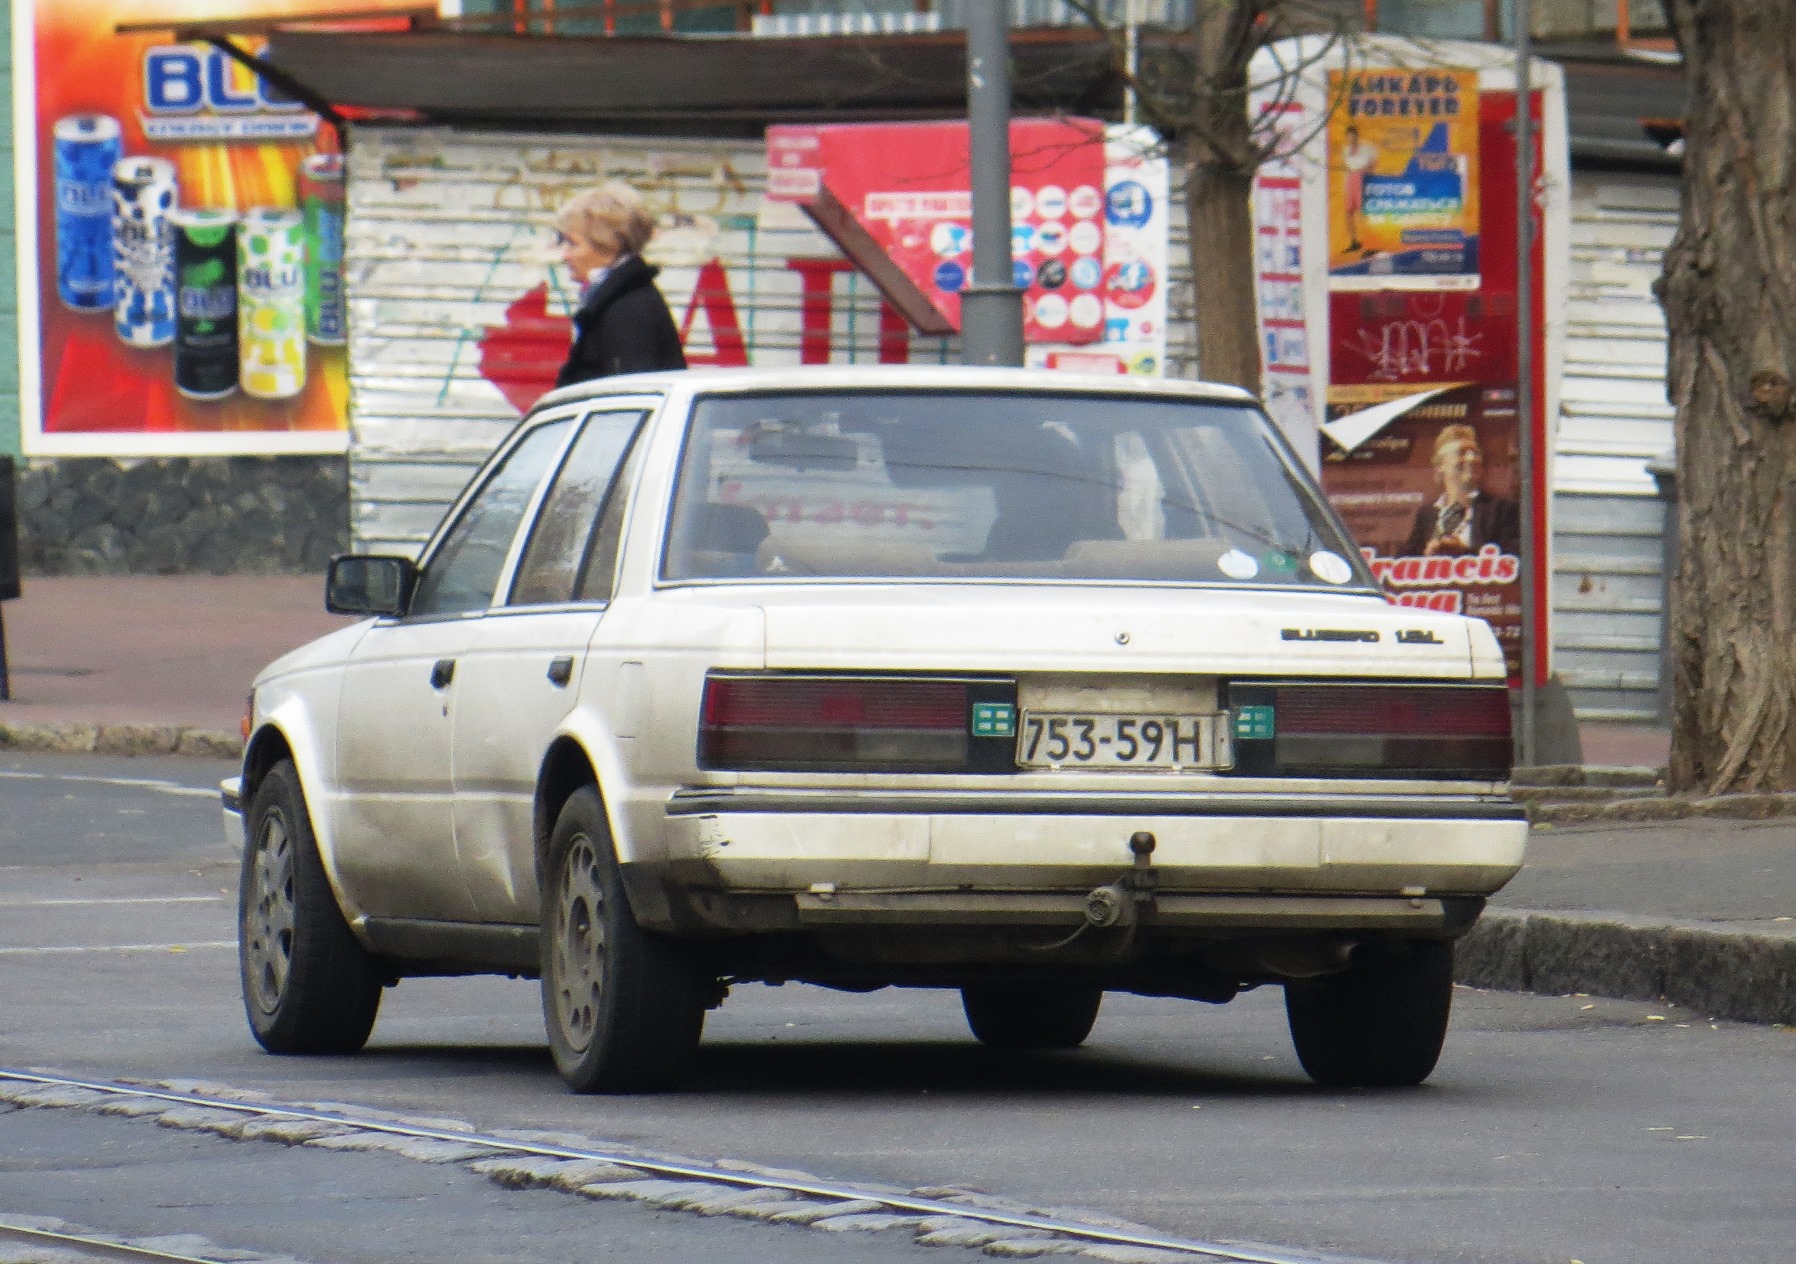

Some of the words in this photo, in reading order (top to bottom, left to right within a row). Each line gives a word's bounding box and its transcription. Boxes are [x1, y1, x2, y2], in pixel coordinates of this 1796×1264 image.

[146, 50, 307, 111] BL
[246, 268, 297, 288] BLU
[1360, 545, 1518, 584] rancis
